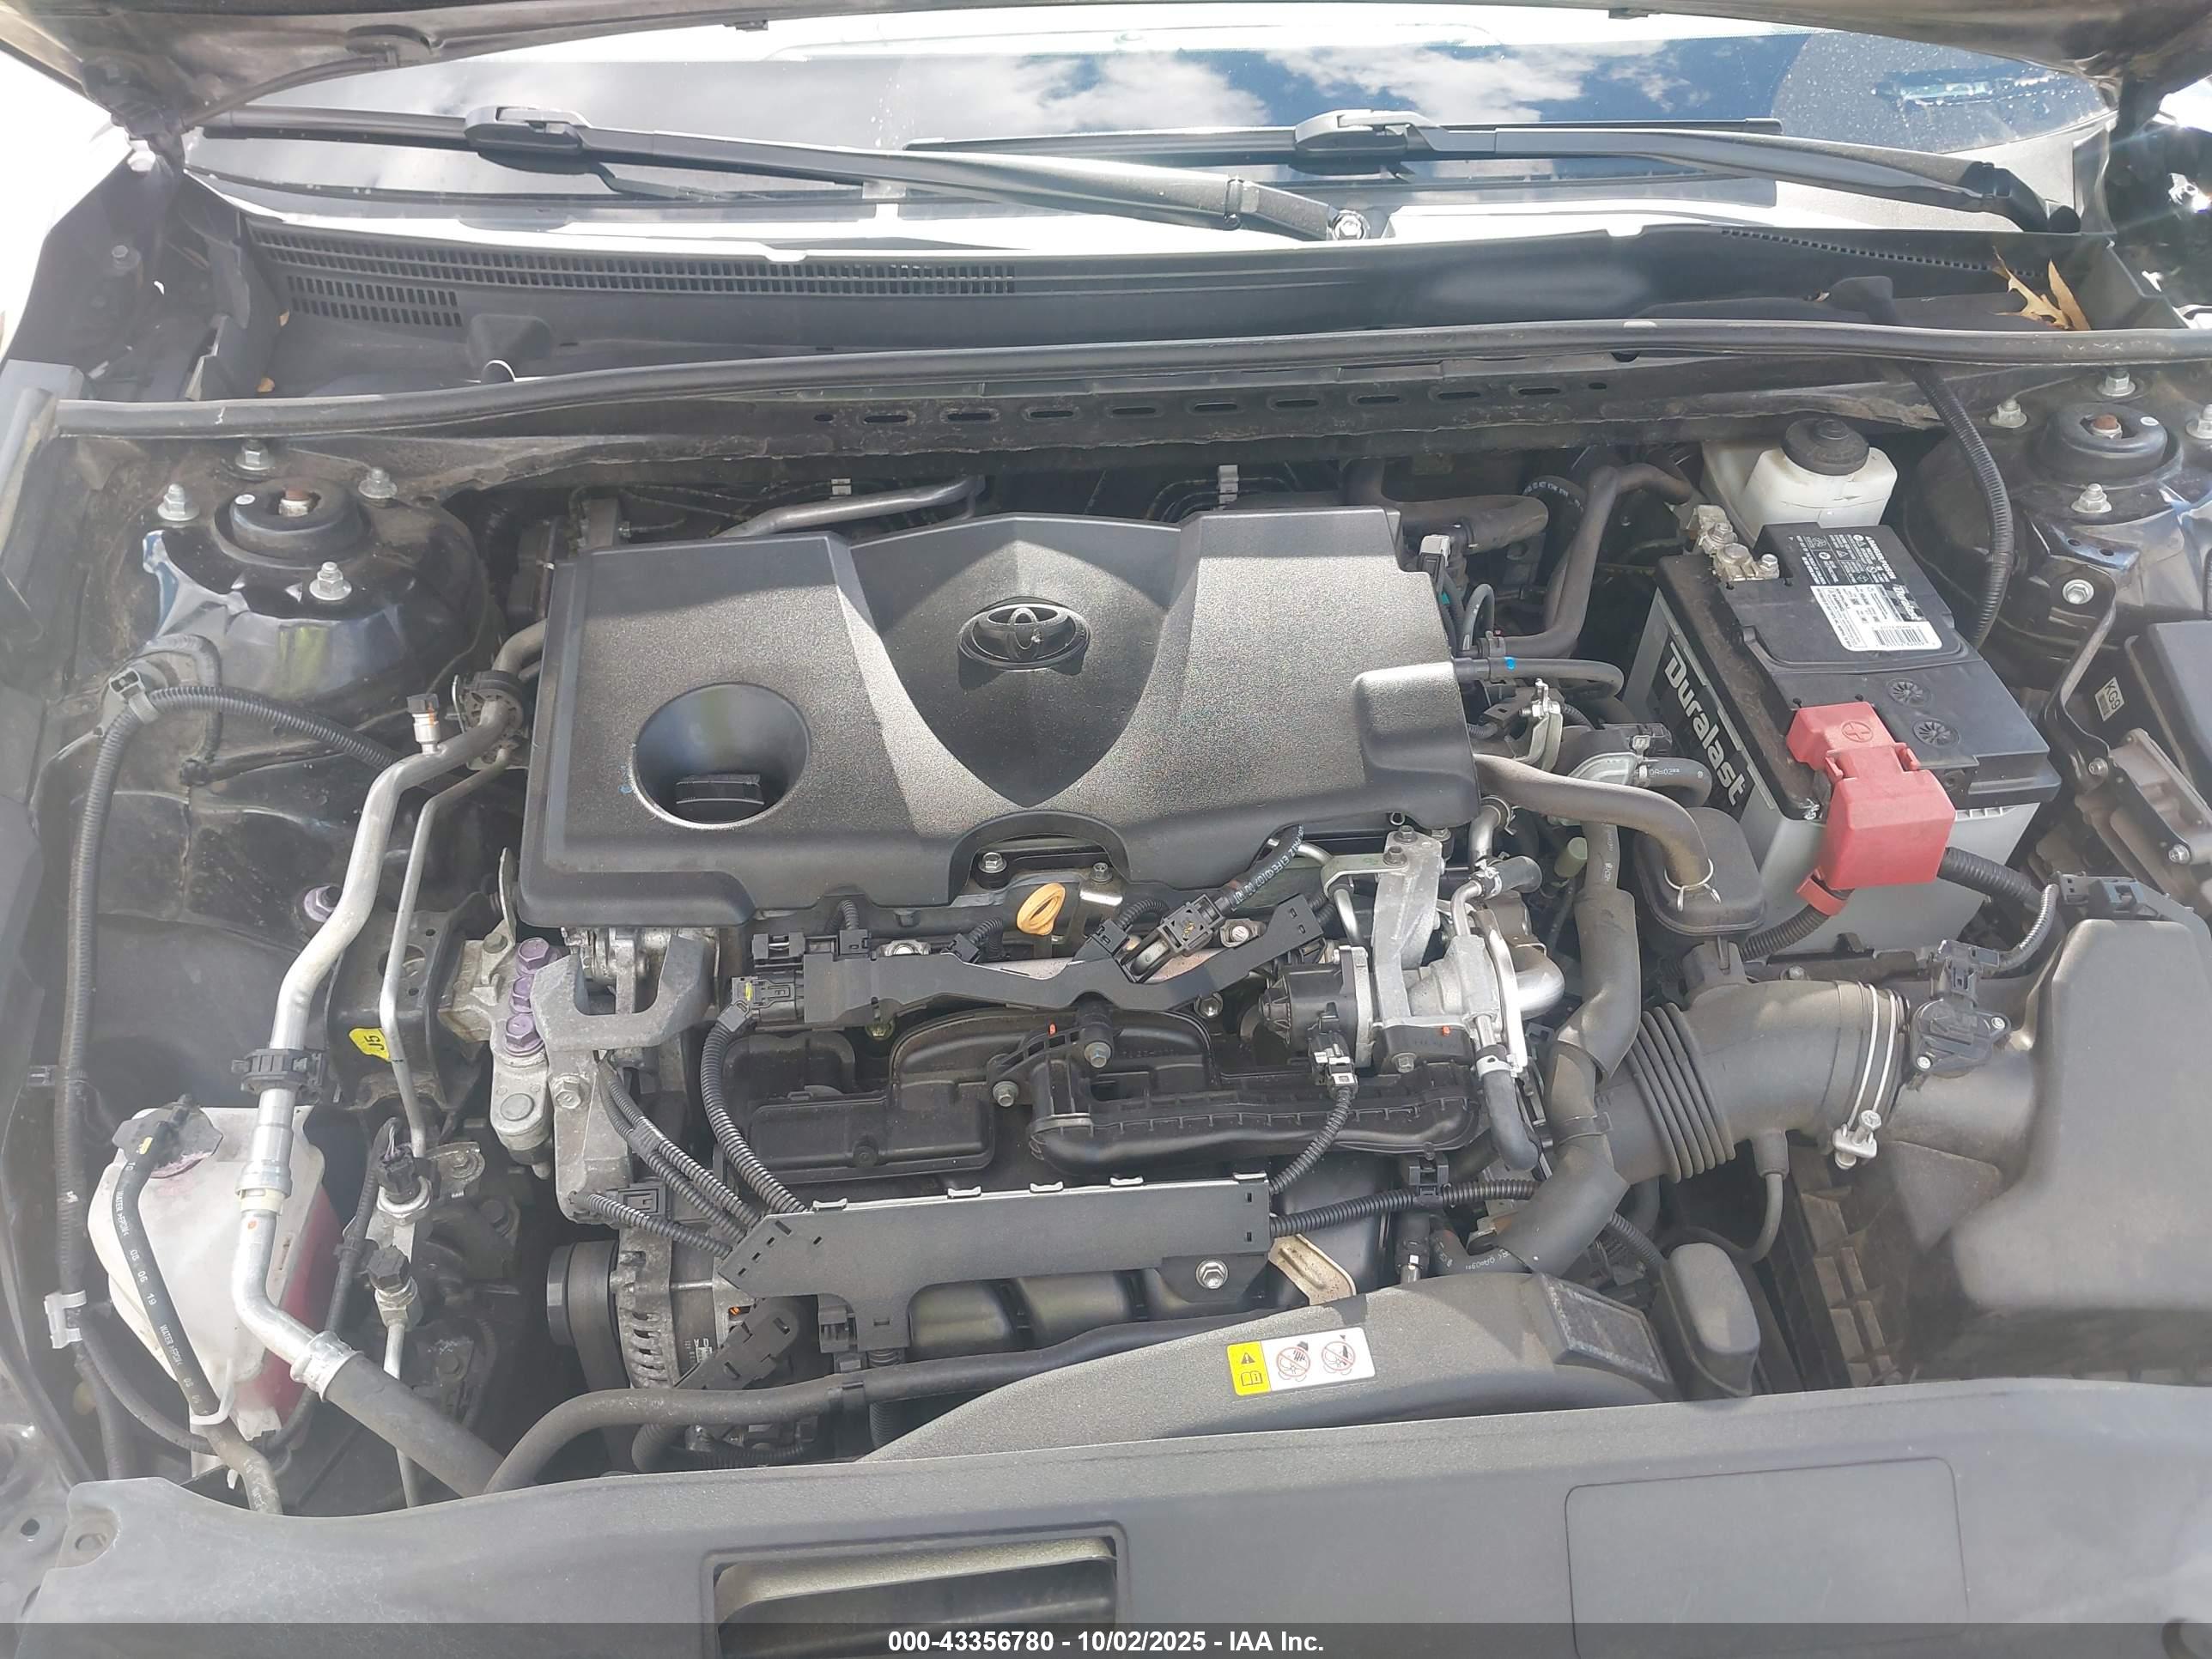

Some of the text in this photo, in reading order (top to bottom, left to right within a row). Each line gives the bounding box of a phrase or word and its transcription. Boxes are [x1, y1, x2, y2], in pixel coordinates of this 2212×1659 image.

[1893, 584, 1923, 621] Duralast
[2105, 681, 2121, 710] KG9
[1664, 641, 1746, 806] Duralast
[363, 1035, 385, 1051] J5
[115, 1190, 125, 1212] WATER
[137, 1270, 148, 1283] 06
[146, 1292, 157, 1305] 19
[160, 1324, 174, 1346] WATER
